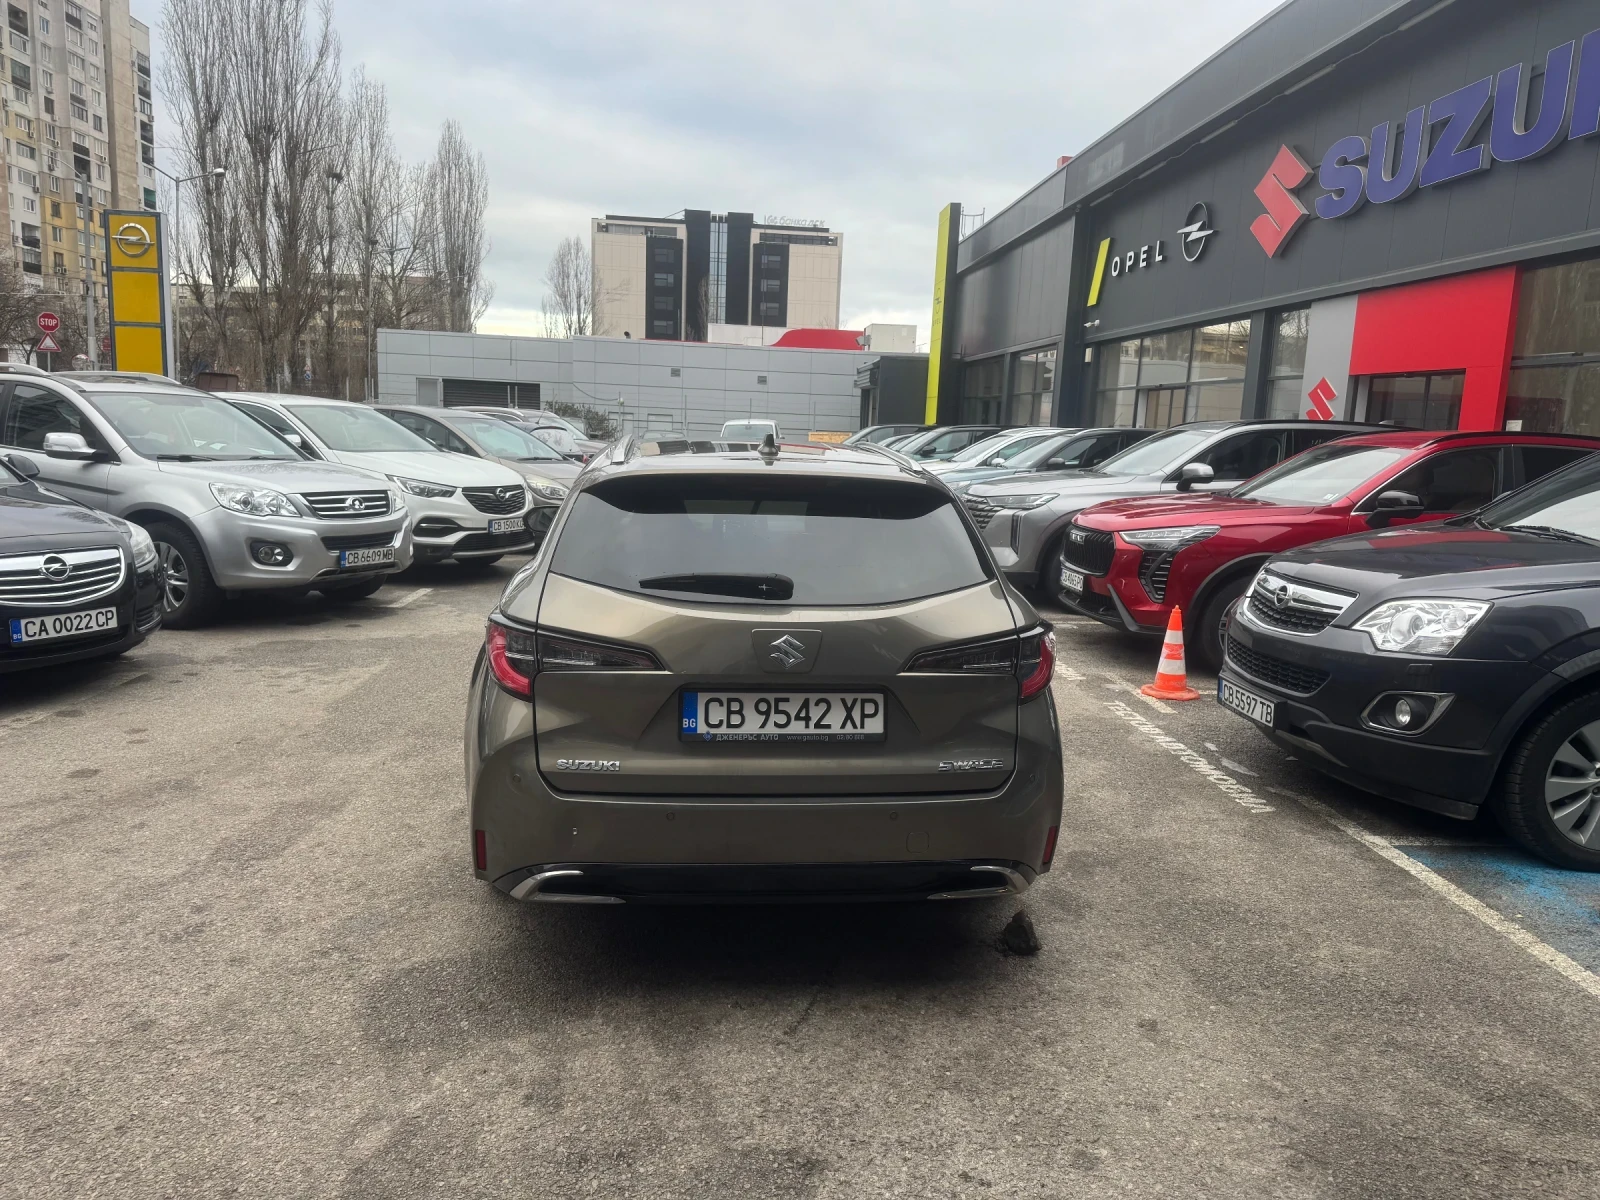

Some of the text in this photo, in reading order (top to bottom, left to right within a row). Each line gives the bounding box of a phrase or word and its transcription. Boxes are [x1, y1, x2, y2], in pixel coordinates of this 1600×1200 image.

[1111, 240, 1163, 277] OPEL
[40, 318, 57, 326] STOP
[494, 521, 502, 531] CB
[347, 552, 359, 565] CB
[361, 550, 382, 563] 6609
[382, 549, 393, 561] MB
[24, 610, 114, 638] CA 0022 CP
[1223, 684, 1273, 724] CB 5597 TB
[704, 697, 880, 730] CB 9542 XP
[682, 718, 696, 728] BG
[556, 759, 620, 771] SUZUKI
